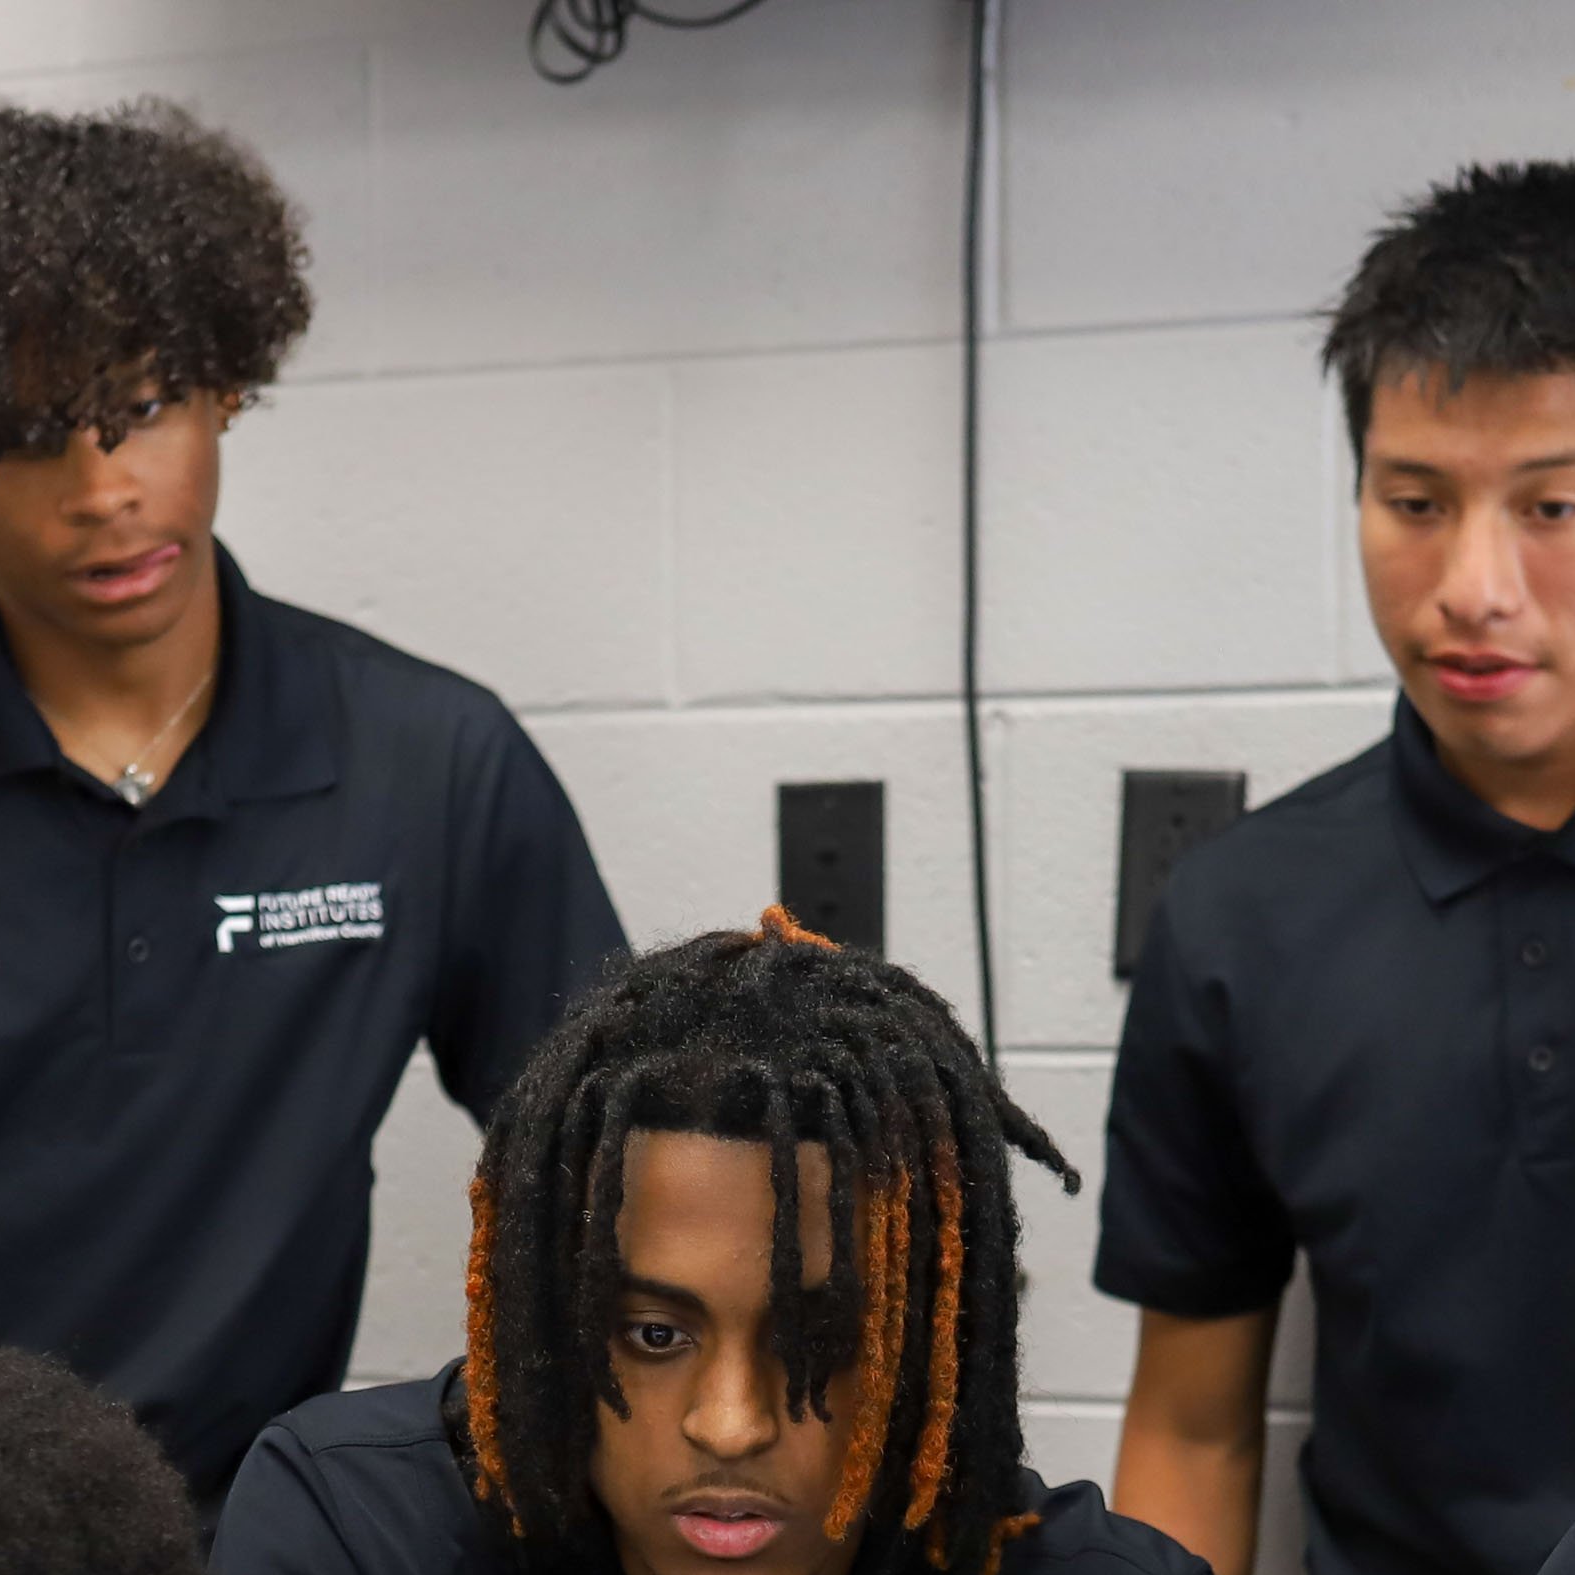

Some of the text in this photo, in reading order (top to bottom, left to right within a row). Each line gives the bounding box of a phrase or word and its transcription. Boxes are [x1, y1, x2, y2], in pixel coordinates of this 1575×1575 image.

[258, 882, 382, 912] FUTURE READY
[259, 901, 383, 931] INSTITUTES
